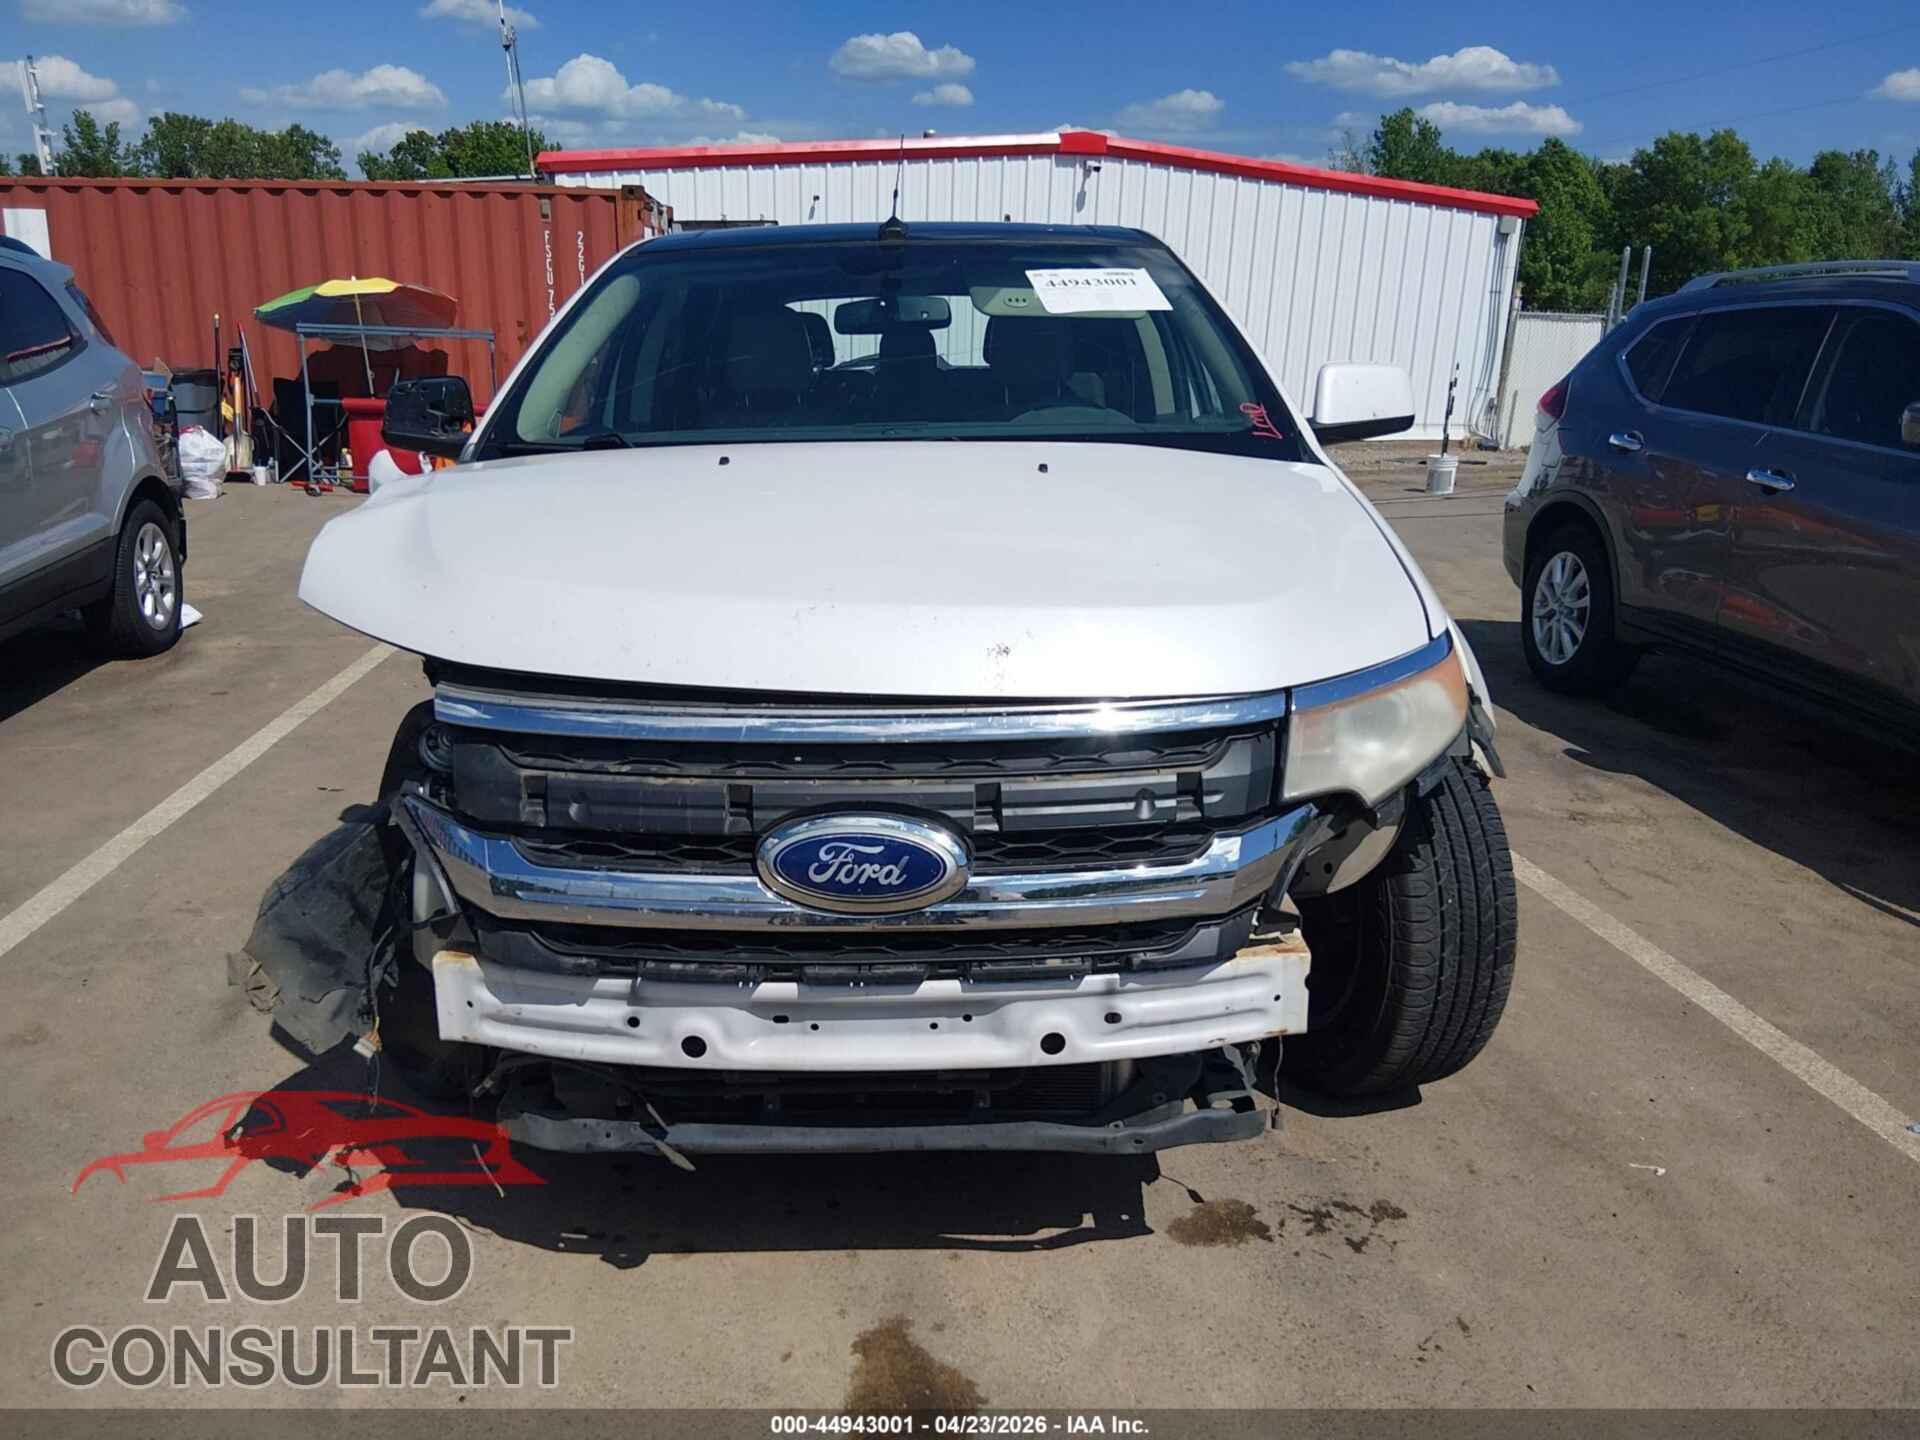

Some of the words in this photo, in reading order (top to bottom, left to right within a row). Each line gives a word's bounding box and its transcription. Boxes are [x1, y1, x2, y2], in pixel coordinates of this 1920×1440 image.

[544, 230, 554, 286] FSCU
[1046, 278, 1137, 288] 44943001
[548, 289, 556, 320] 75
[808, 842, 909, 885] Ford
